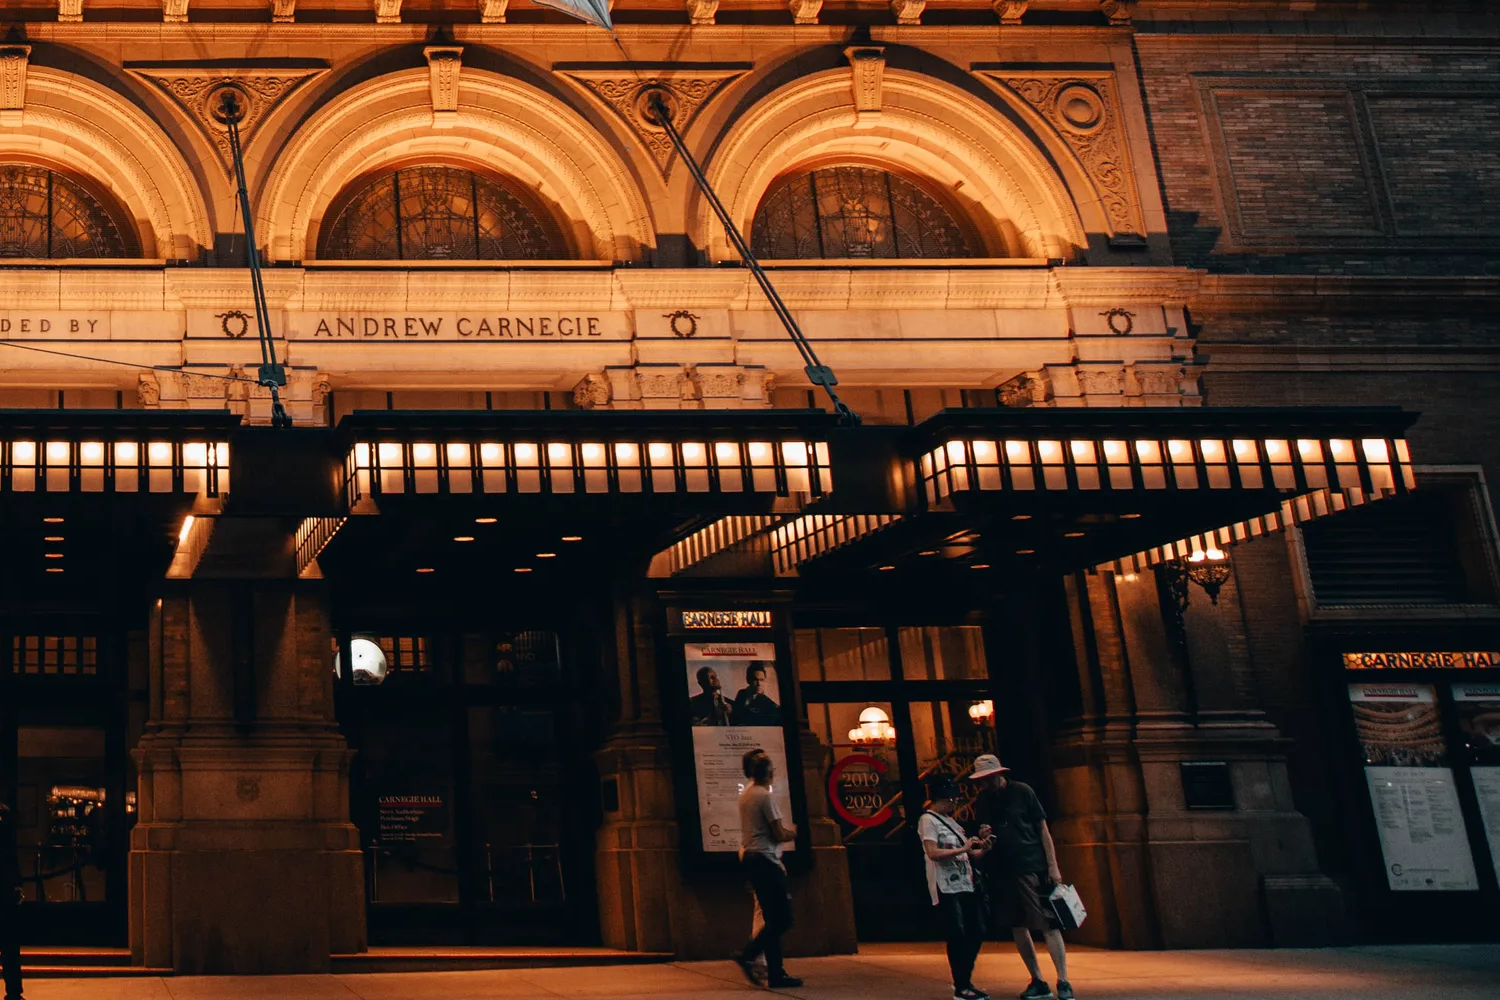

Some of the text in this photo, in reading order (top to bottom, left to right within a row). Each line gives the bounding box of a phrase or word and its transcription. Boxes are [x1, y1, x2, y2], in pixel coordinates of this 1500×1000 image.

[69, 319, 98, 333] BY
[314, 317, 602, 338] ANDREW CARNEGIE
[683, 611, 772, 627] CARNEGIE HALL
[1361, 652, 1454, 668] CARNEGIE
[842, 772, 879, 787] 2019
[845, 794, 882, 809] 2020
